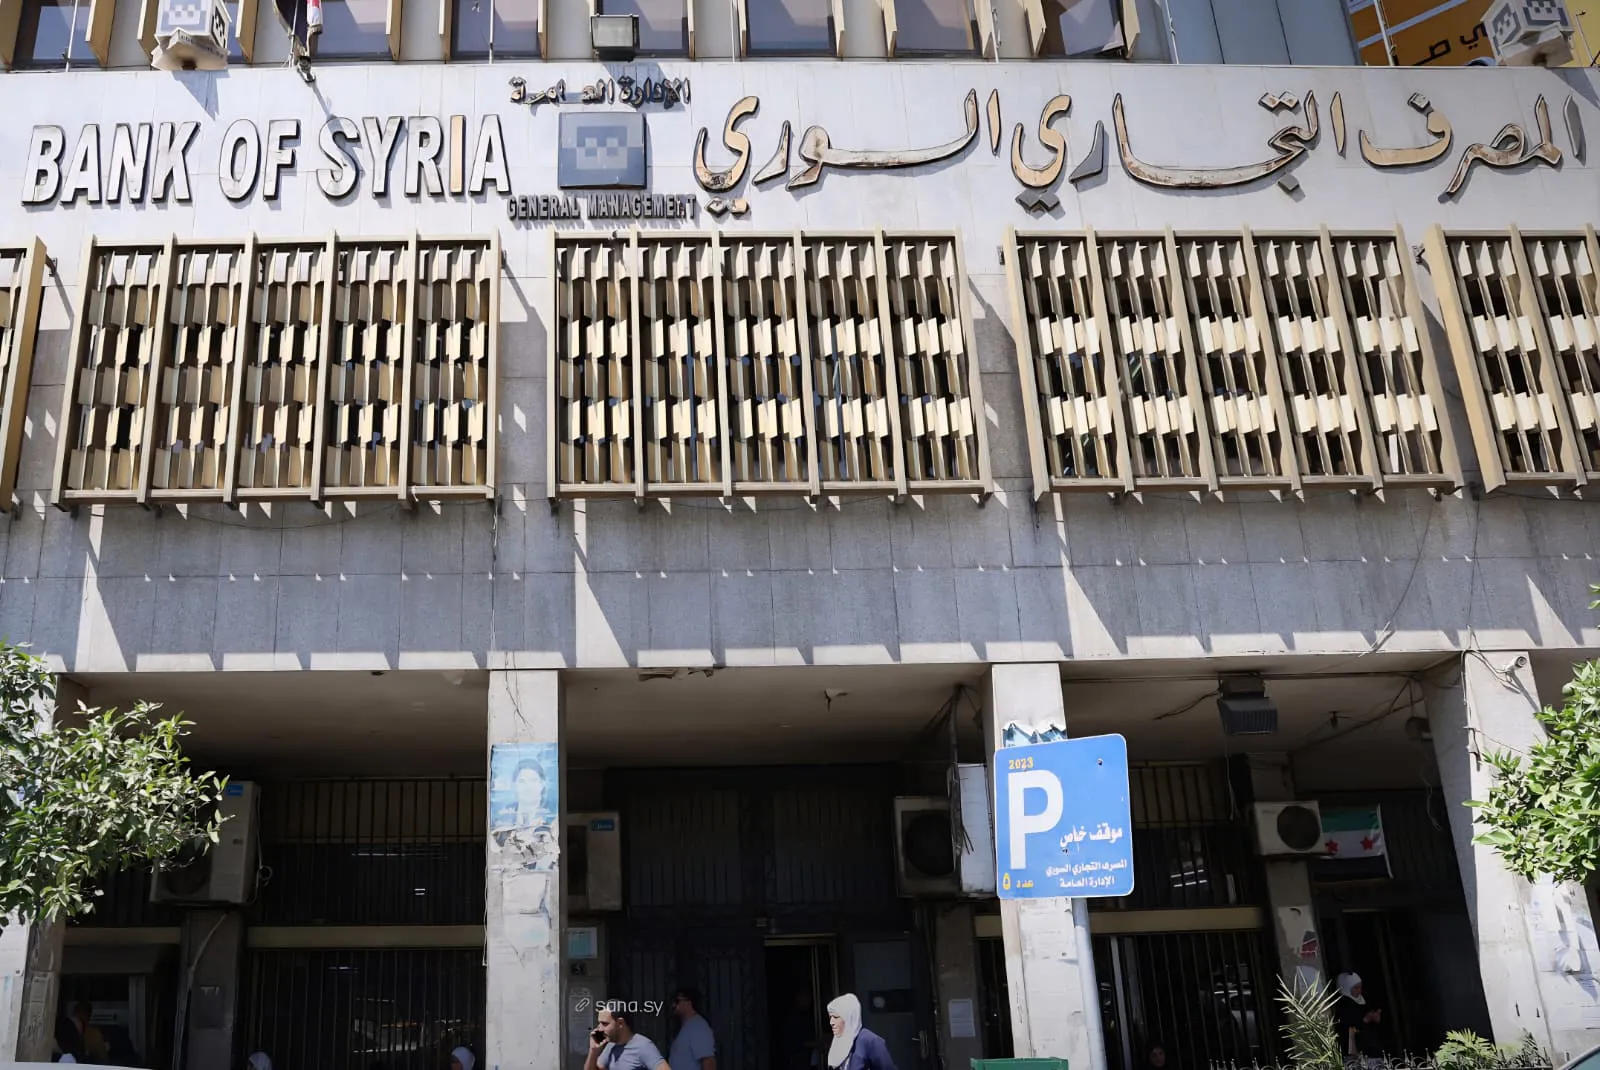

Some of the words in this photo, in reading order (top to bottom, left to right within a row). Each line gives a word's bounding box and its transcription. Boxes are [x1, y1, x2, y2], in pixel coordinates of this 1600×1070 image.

[692, 88, 1000, 217] السوري
[1010, 89, 1346, 214] التجاري
[1359, 91, 1587, 203] المصرف
[21, 121, 200, 206] BANK
[218, 118, 300, 201] OF
[315, 114, 512, 198] SYRIA
[507, 194, 581, 220] GENERAL
[1008, 757, 1034, 770] 2023
[1008, 769, 1064, 870] P
[1060, 825, 1087, 848] خاص
[1088, 822, 1123, 844] موقف
[1045, 863, 1071, 878] السوري
[1072, 861, 1101, 876] التجاري
[1059, 877, 1088, 888] العامة
